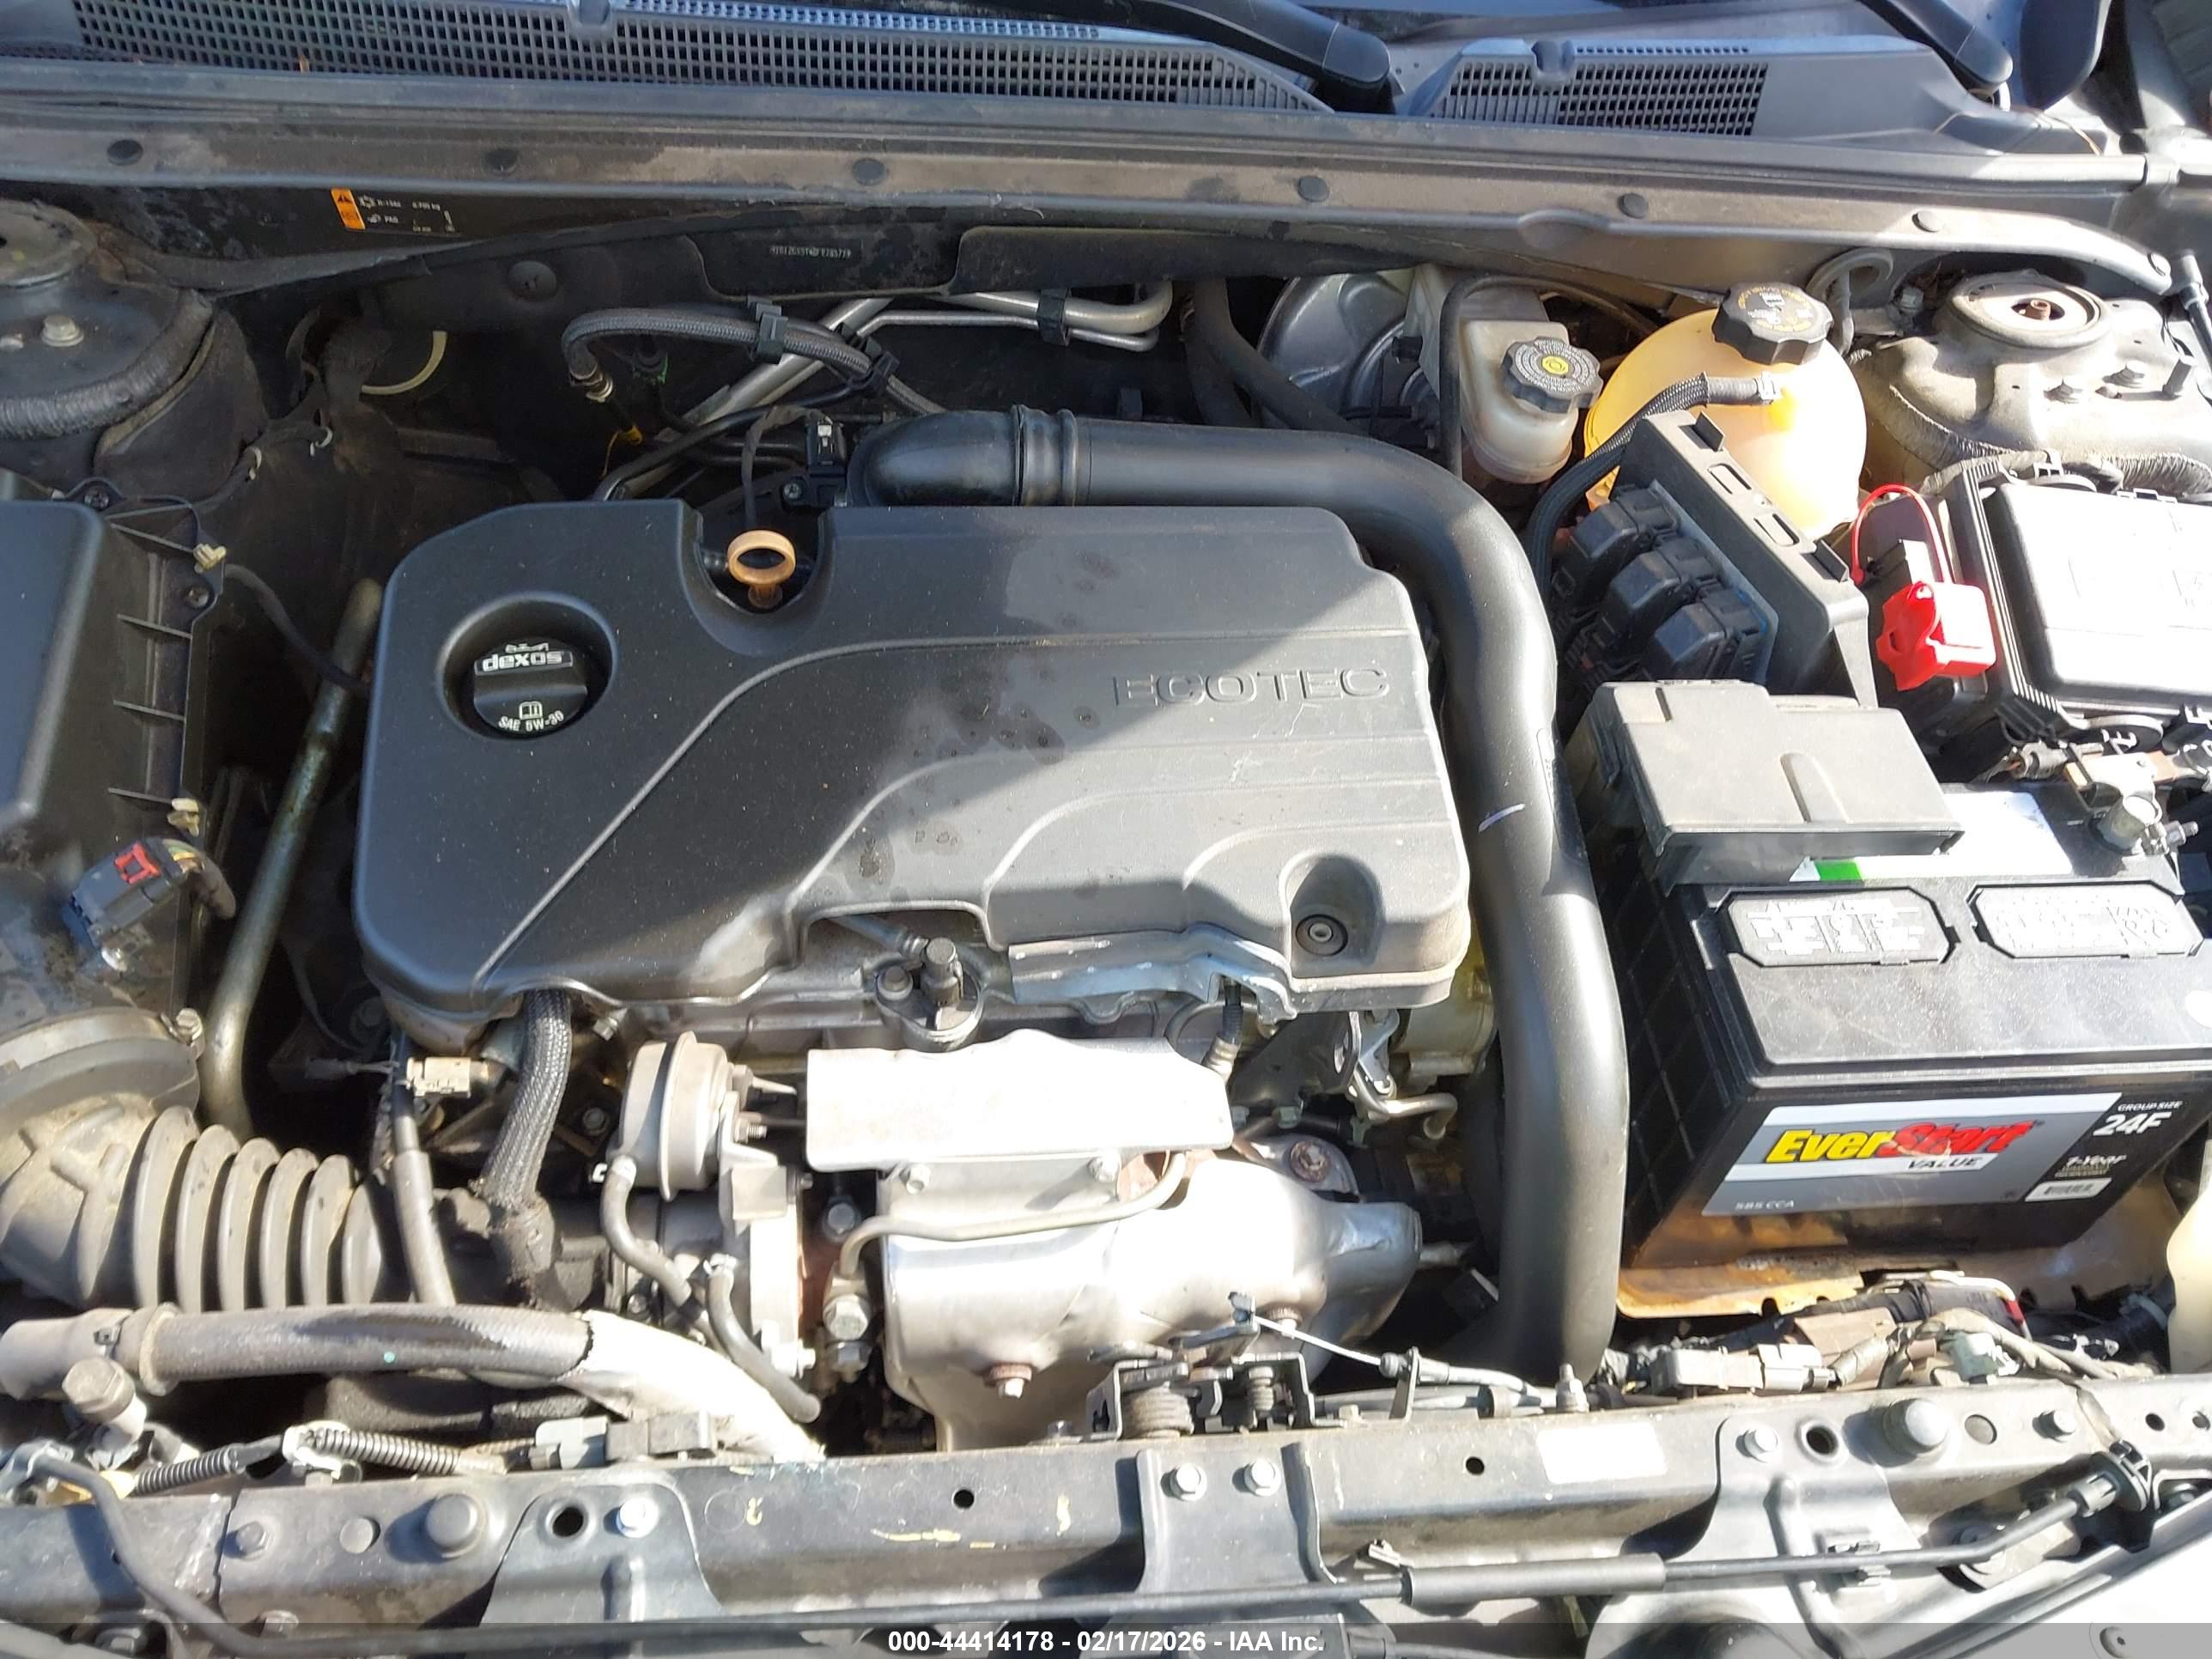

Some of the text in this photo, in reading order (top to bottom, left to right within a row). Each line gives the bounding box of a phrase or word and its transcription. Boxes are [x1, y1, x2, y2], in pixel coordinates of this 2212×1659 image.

[483, 651, 562, 672] dexos
[1113, 666, 1389, 706] ECOTEC
[498, 710, 564, 732] SAE 5W-30
[2093, 1111, 2172, 1136] 24F
[1765, 1121, 2035, 1164] EverStart
[1908, 1156, 1982, 1170] VALUE
